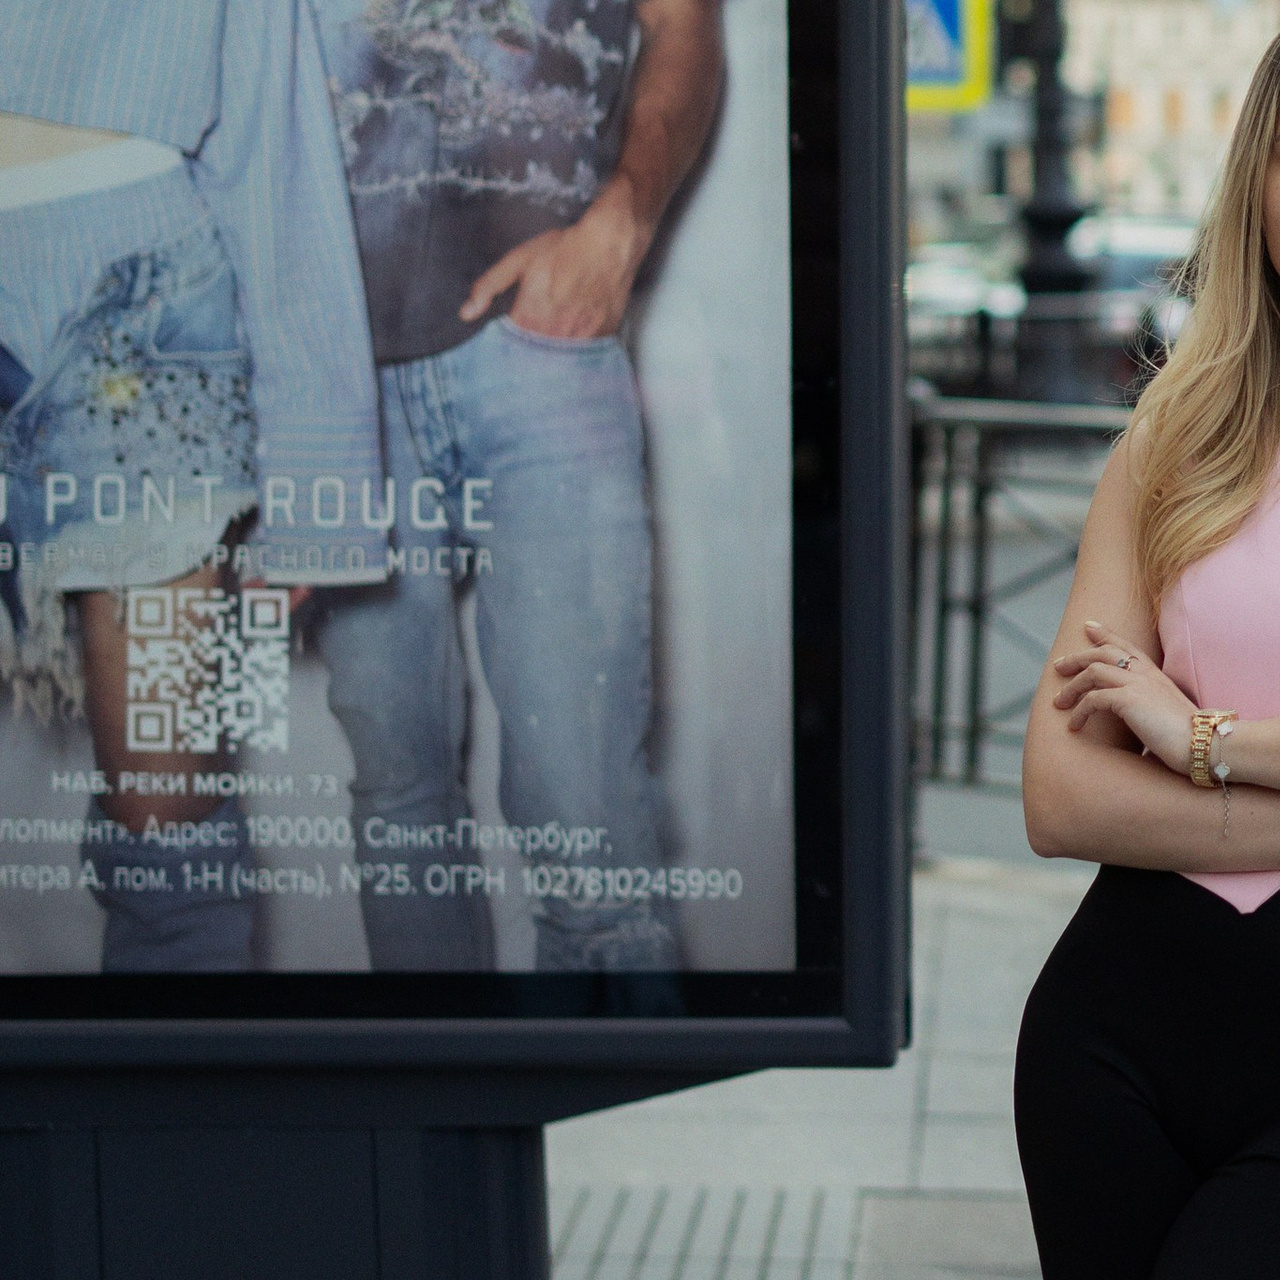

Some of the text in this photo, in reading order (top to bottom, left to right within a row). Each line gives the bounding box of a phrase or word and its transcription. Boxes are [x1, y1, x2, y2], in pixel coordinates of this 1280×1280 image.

[45, 473, 224, 524] PONT
[264, 475, 494, 531] ROUGE
[386, 546, 494, 576] МОСТА
[52, 771, 113, 794] НАБ.
[119, 772, 187, 795] РЕКИ
[310, 774, 339, 798] 73
[142, 815, 238, 851] Адрес:
[363, 816, 613, 859] Санкт-Петербург,
[181, 861, 224, 892] 1-Н
[424, 863, 505, 896] ОГРН
[522, 866, 743, 899] 1027810245990
